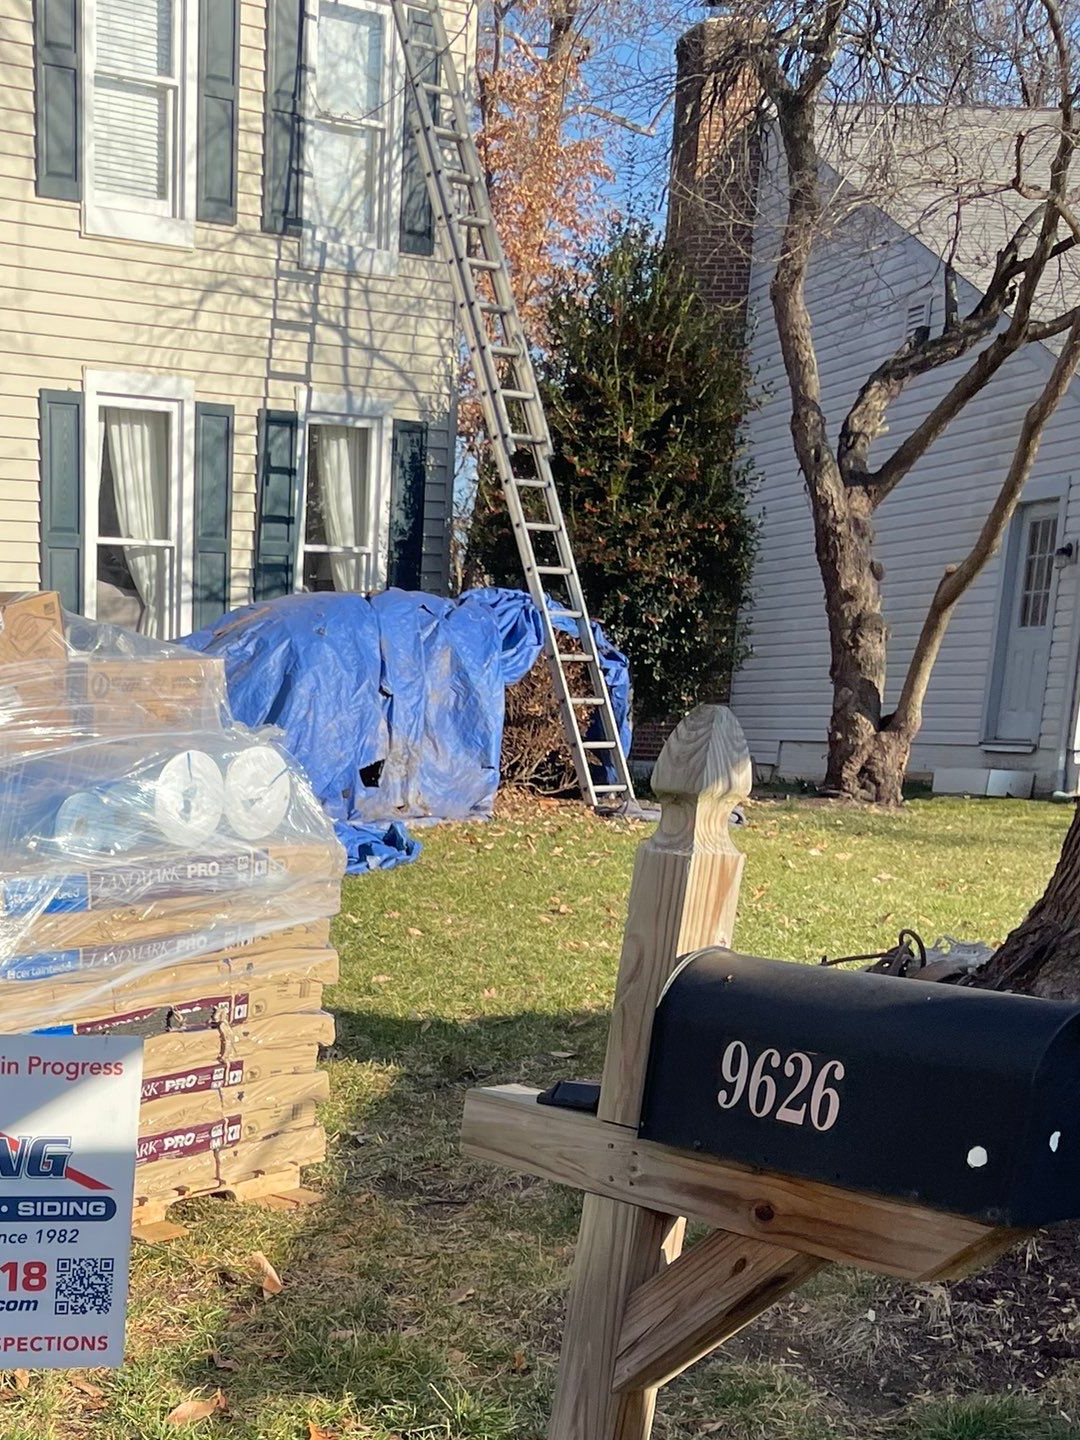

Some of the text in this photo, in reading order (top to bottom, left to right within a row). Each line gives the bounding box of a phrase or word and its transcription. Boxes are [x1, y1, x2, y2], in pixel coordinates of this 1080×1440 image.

[98, 864, 180, 890] LANDMARK
[187, 861, 220, 878] PRO
[176, 934, 208, 951] PRO
[1, 1056, 19, 1075] in
[28, 1056, 124, 1081] Progress
[164, 1075, 198, 1093] PRO
[717, 1040, 846, 1132] 9626
[162, 1132, 196, 1151] PRO
[18, 1201, 107, 1217] SIDING
[35, 1228, 80, 1244] 1982
